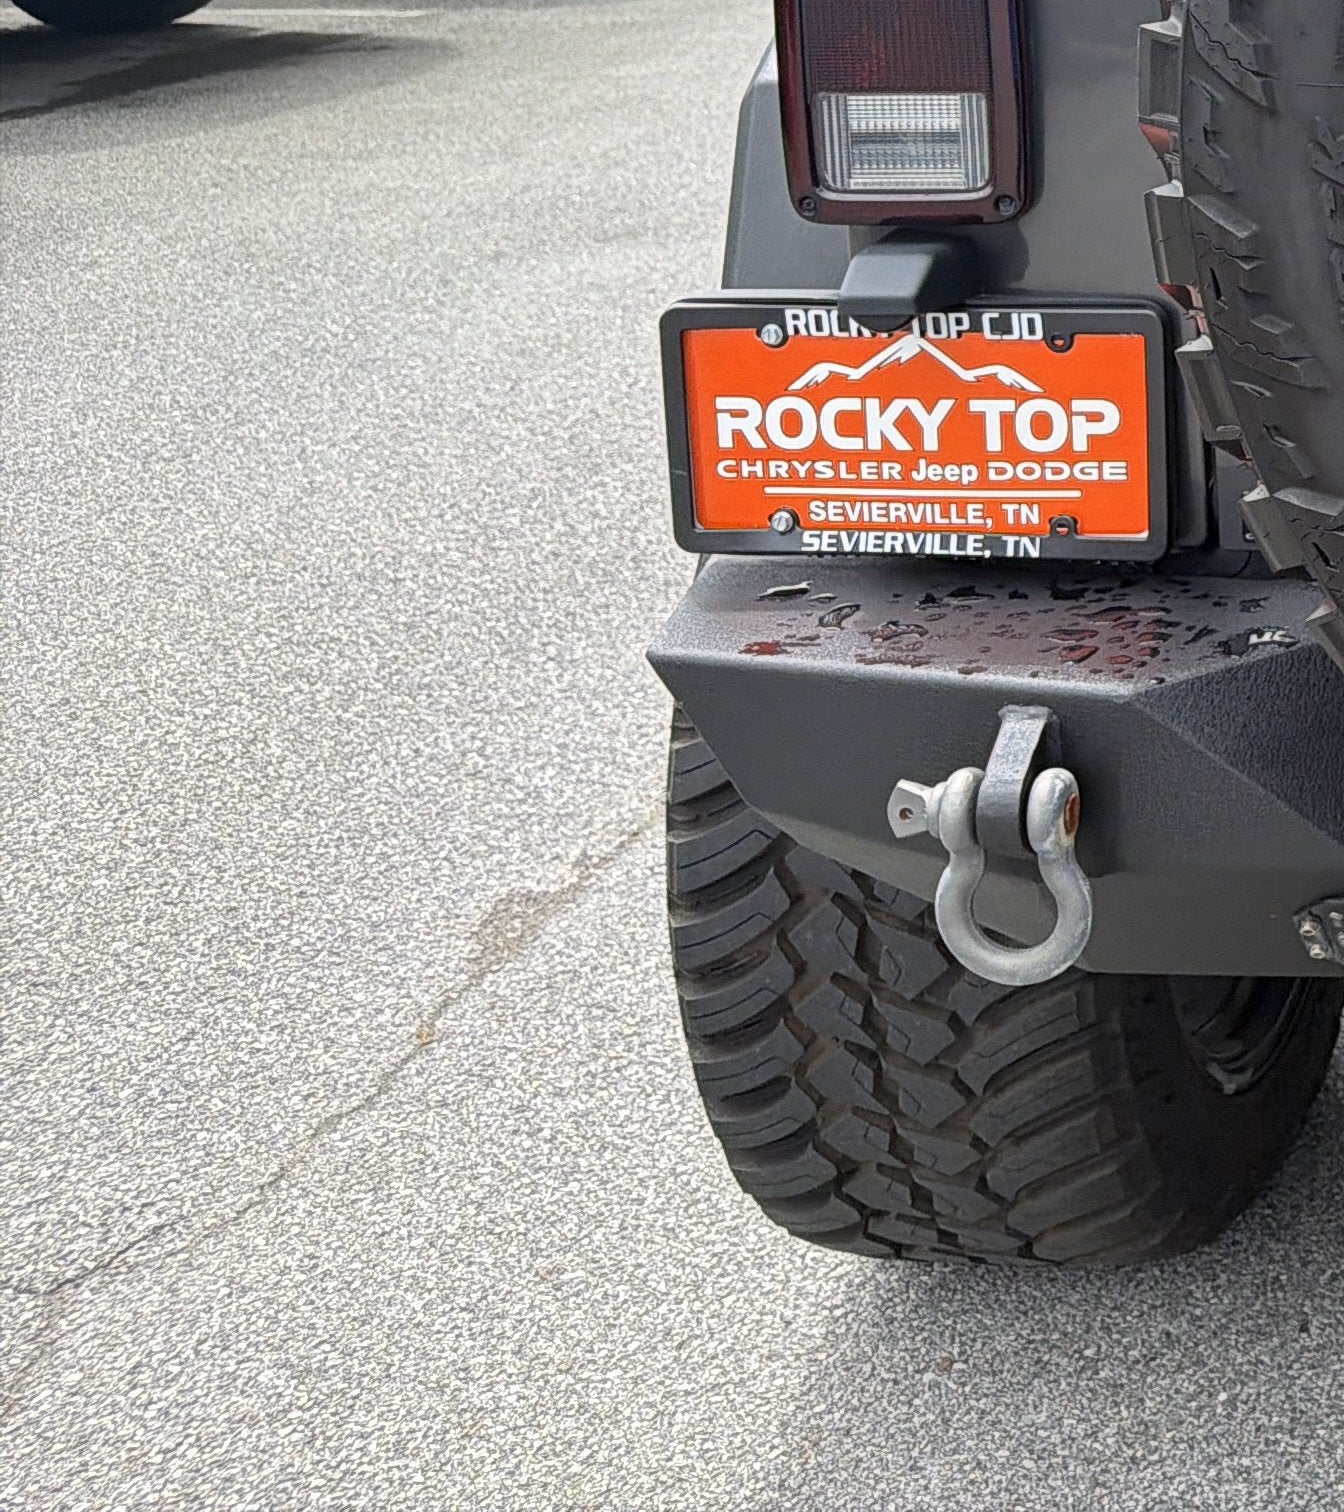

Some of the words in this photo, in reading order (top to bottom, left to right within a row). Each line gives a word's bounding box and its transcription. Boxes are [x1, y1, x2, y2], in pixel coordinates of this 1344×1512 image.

[981, 311, 1043, 341] CJD
[715, 395, 957, 452] ROCKY
[967, 397, 1121, 453] TOP
[717, 459, 903, 482] CHRYSLER
[911, 458, 979, 485] Jeep
[988, 460, 1128, 482] DODGE
[809, 500, 993, 530] SEVIERVILLE,
[1001, 502, 1040, 525] TN
[801, 530, 991, 559] SEVIERVILLE,
[1001, 536, 1041, 558] TN
